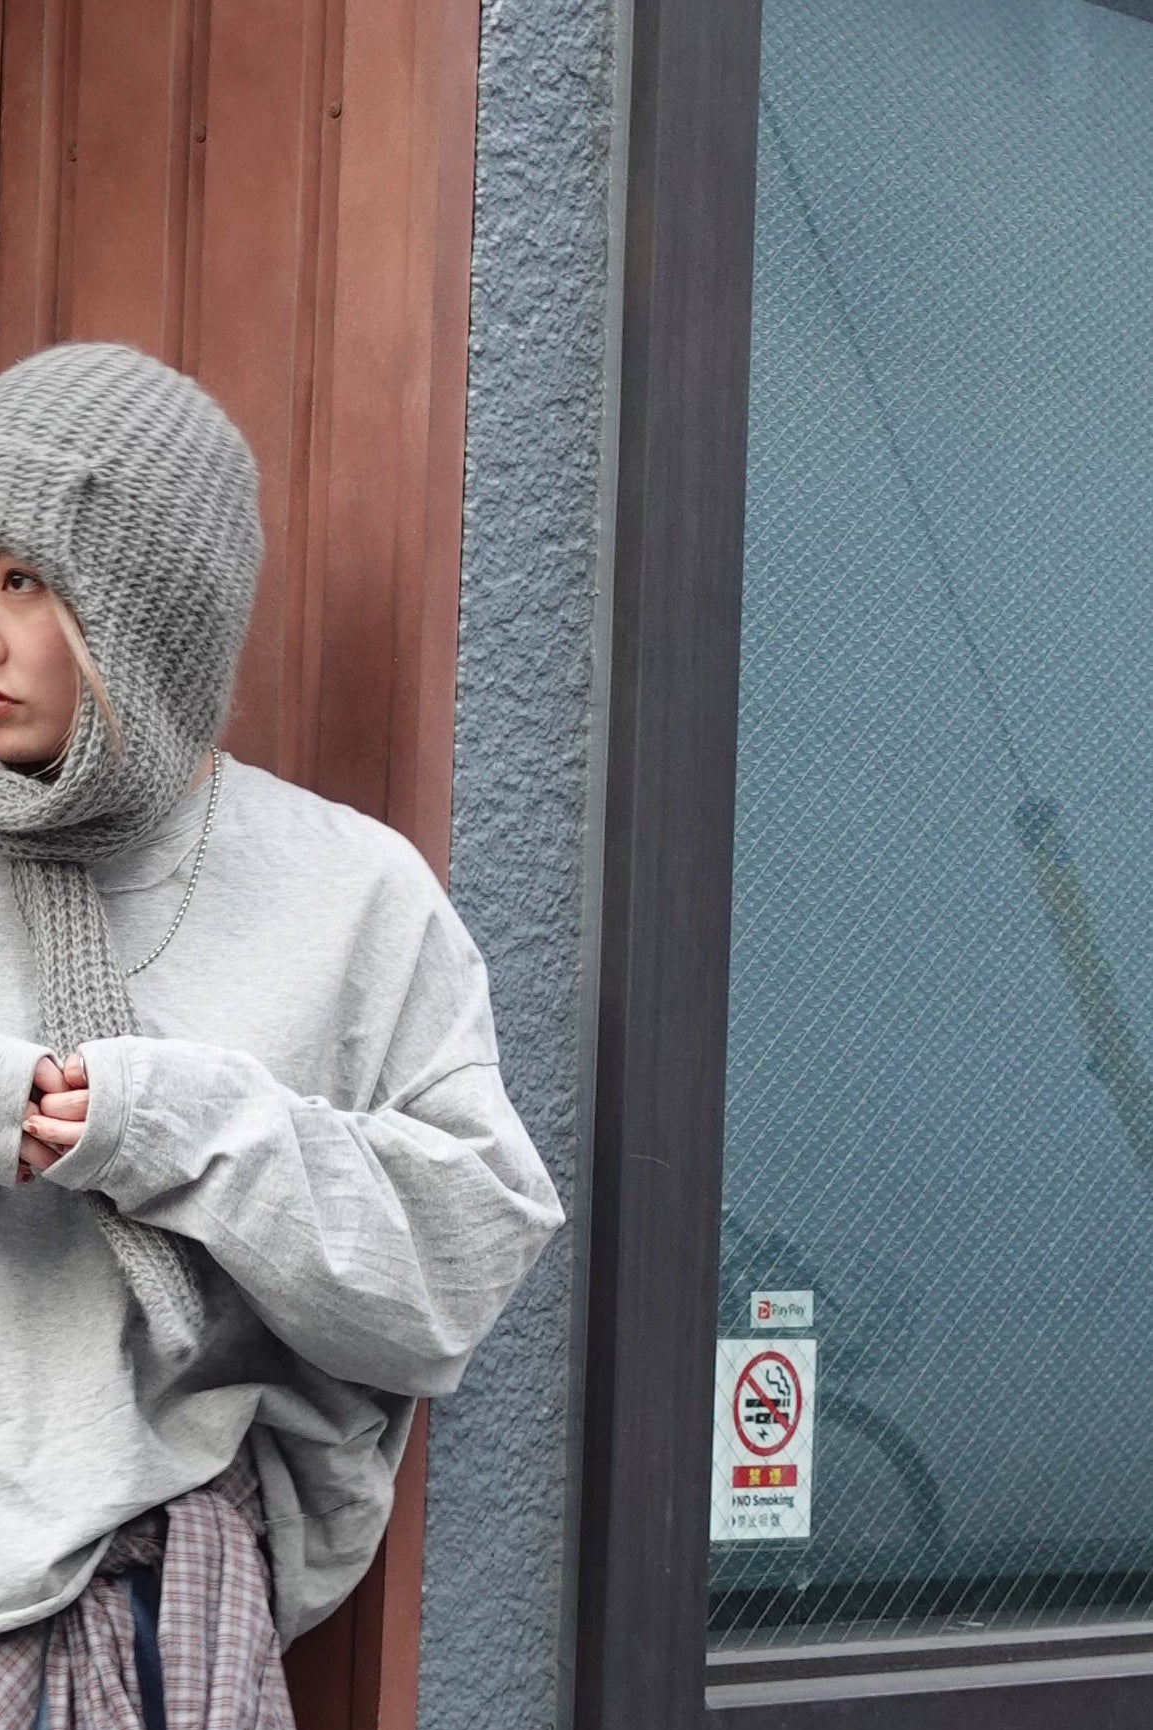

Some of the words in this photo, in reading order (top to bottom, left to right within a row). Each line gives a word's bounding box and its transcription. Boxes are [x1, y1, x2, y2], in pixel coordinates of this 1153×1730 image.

[771, 1303, 806, 1317] PayPay
[736, 1495, 751, 1507] NO
[752, 1493, 795, 1508] Smoking
